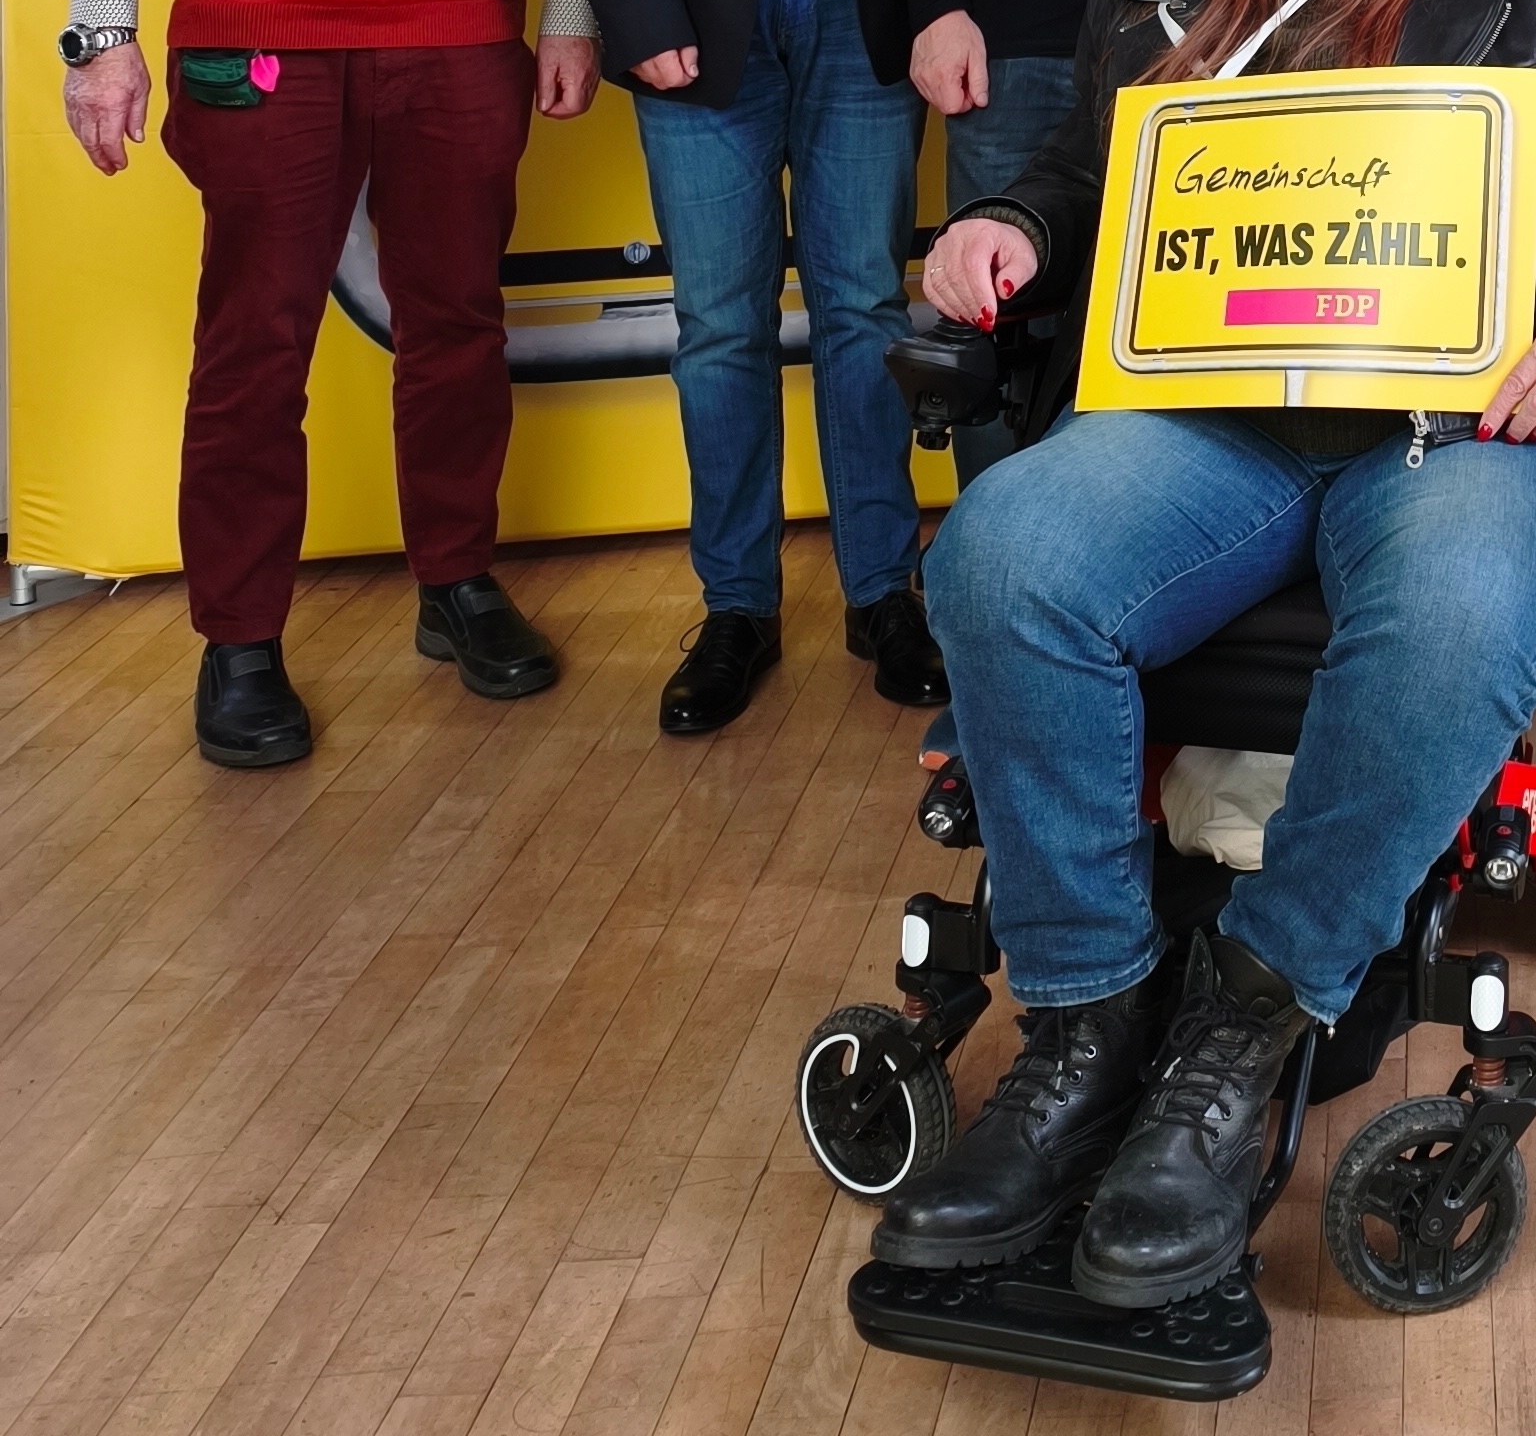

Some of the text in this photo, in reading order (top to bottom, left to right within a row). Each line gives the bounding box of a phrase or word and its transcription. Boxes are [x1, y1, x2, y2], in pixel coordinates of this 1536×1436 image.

[1174, 145, 1391, 197] Gemeinschaft
[1154, 208, 1468, 275] IST, WAS ZÄHLT.
[1314, 294, 1376, 319] FDP
